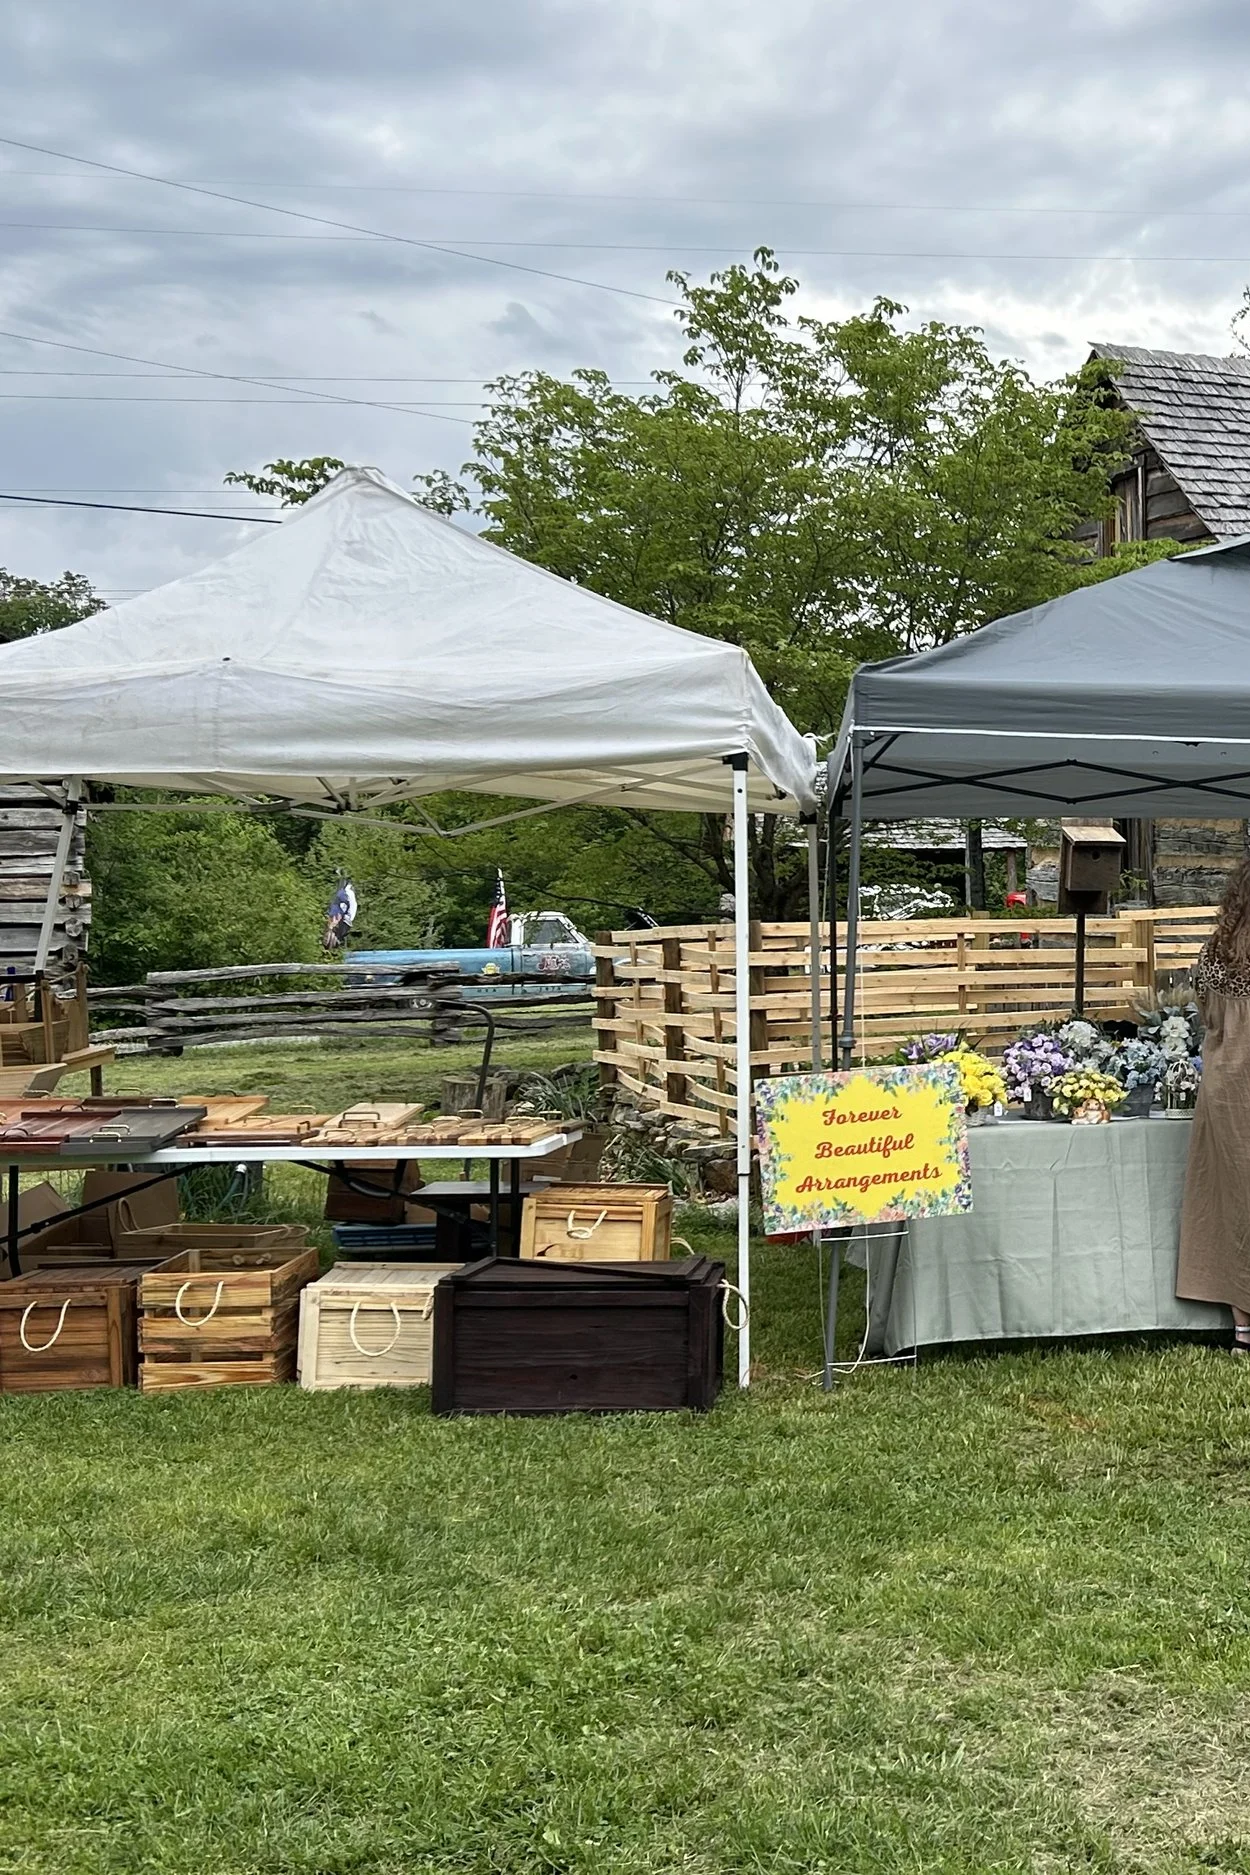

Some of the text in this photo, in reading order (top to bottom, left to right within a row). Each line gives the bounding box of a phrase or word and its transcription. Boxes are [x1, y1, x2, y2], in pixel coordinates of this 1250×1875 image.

[822, 1107, 902, 1126] Forever
[814, 1133, 914, 1159] Beautiful
[795, 1162, 942, 1194] Arrangements
